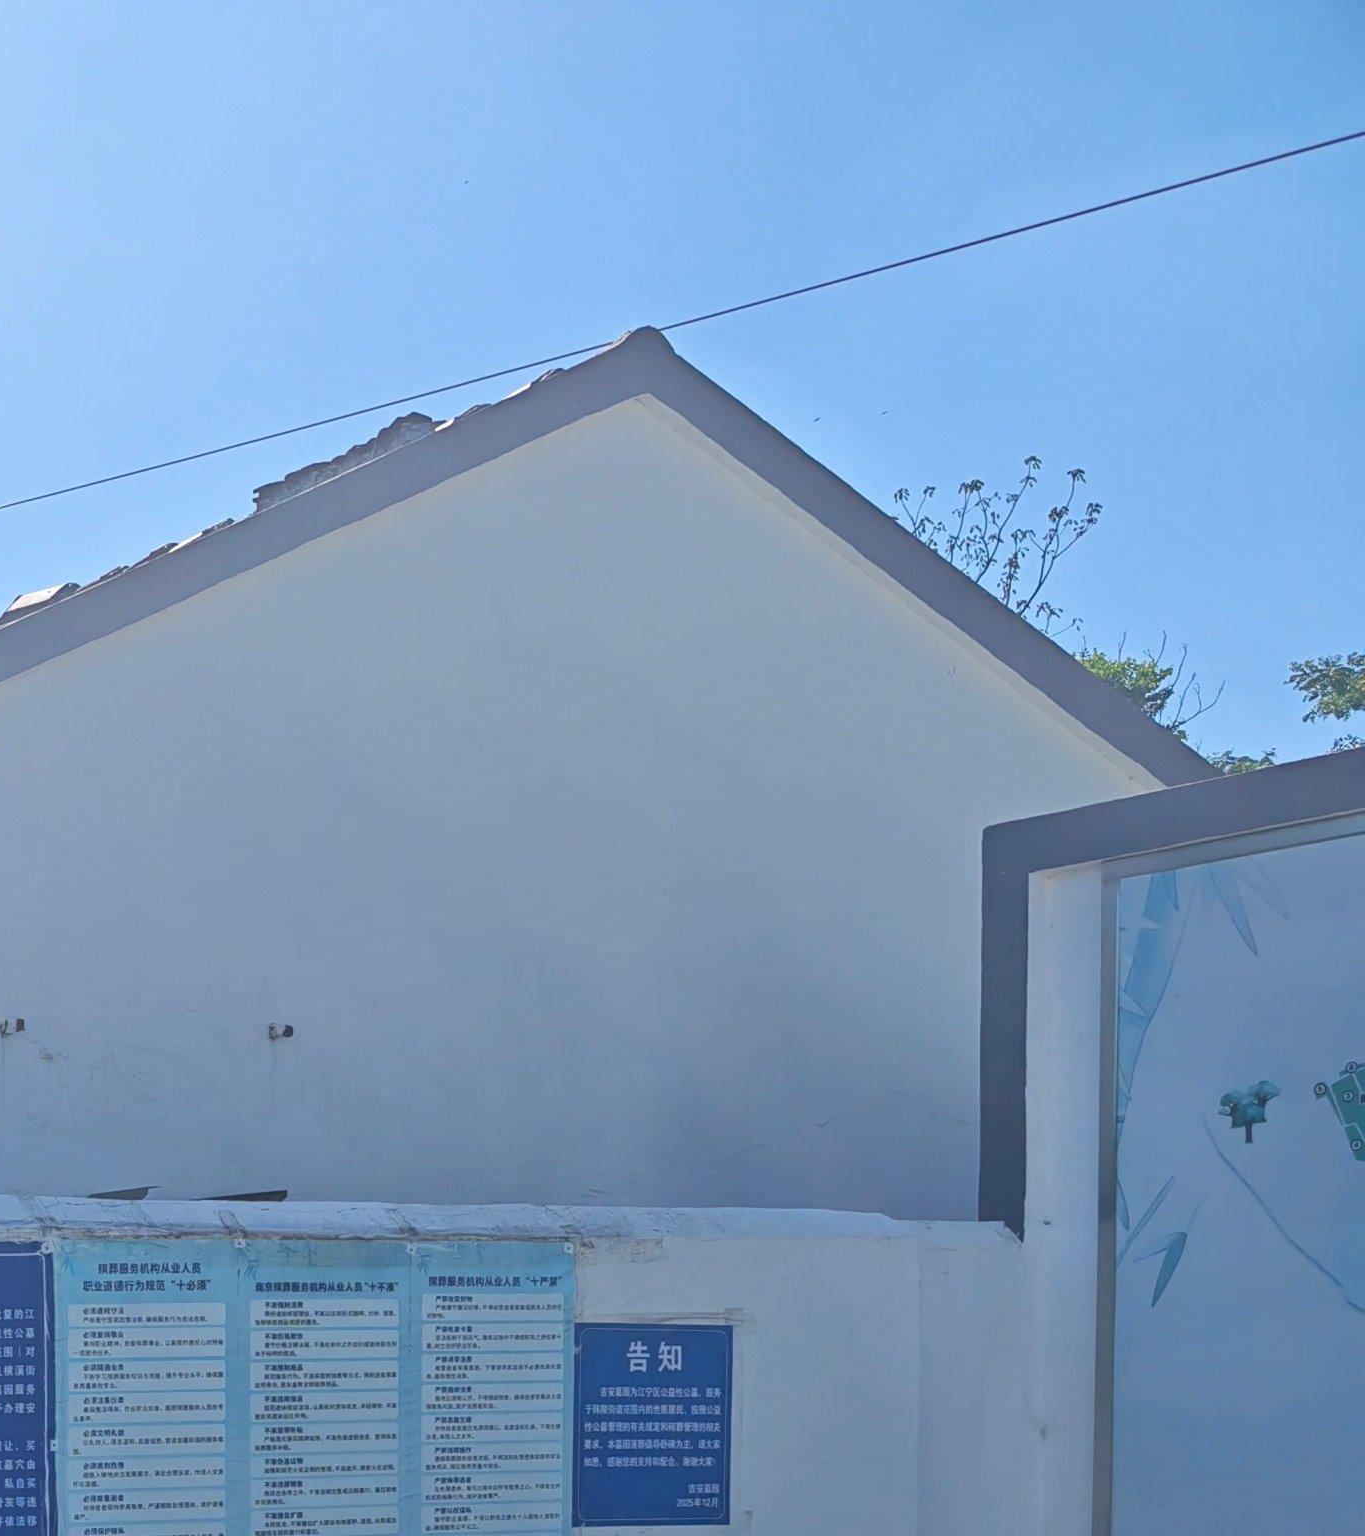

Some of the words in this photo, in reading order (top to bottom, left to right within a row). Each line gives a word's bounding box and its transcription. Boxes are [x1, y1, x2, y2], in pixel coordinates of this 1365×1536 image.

[98, 1261, 201, 1275] 殡葬服务机构从业人员
[626, 1341, 683, 1372] 告知
